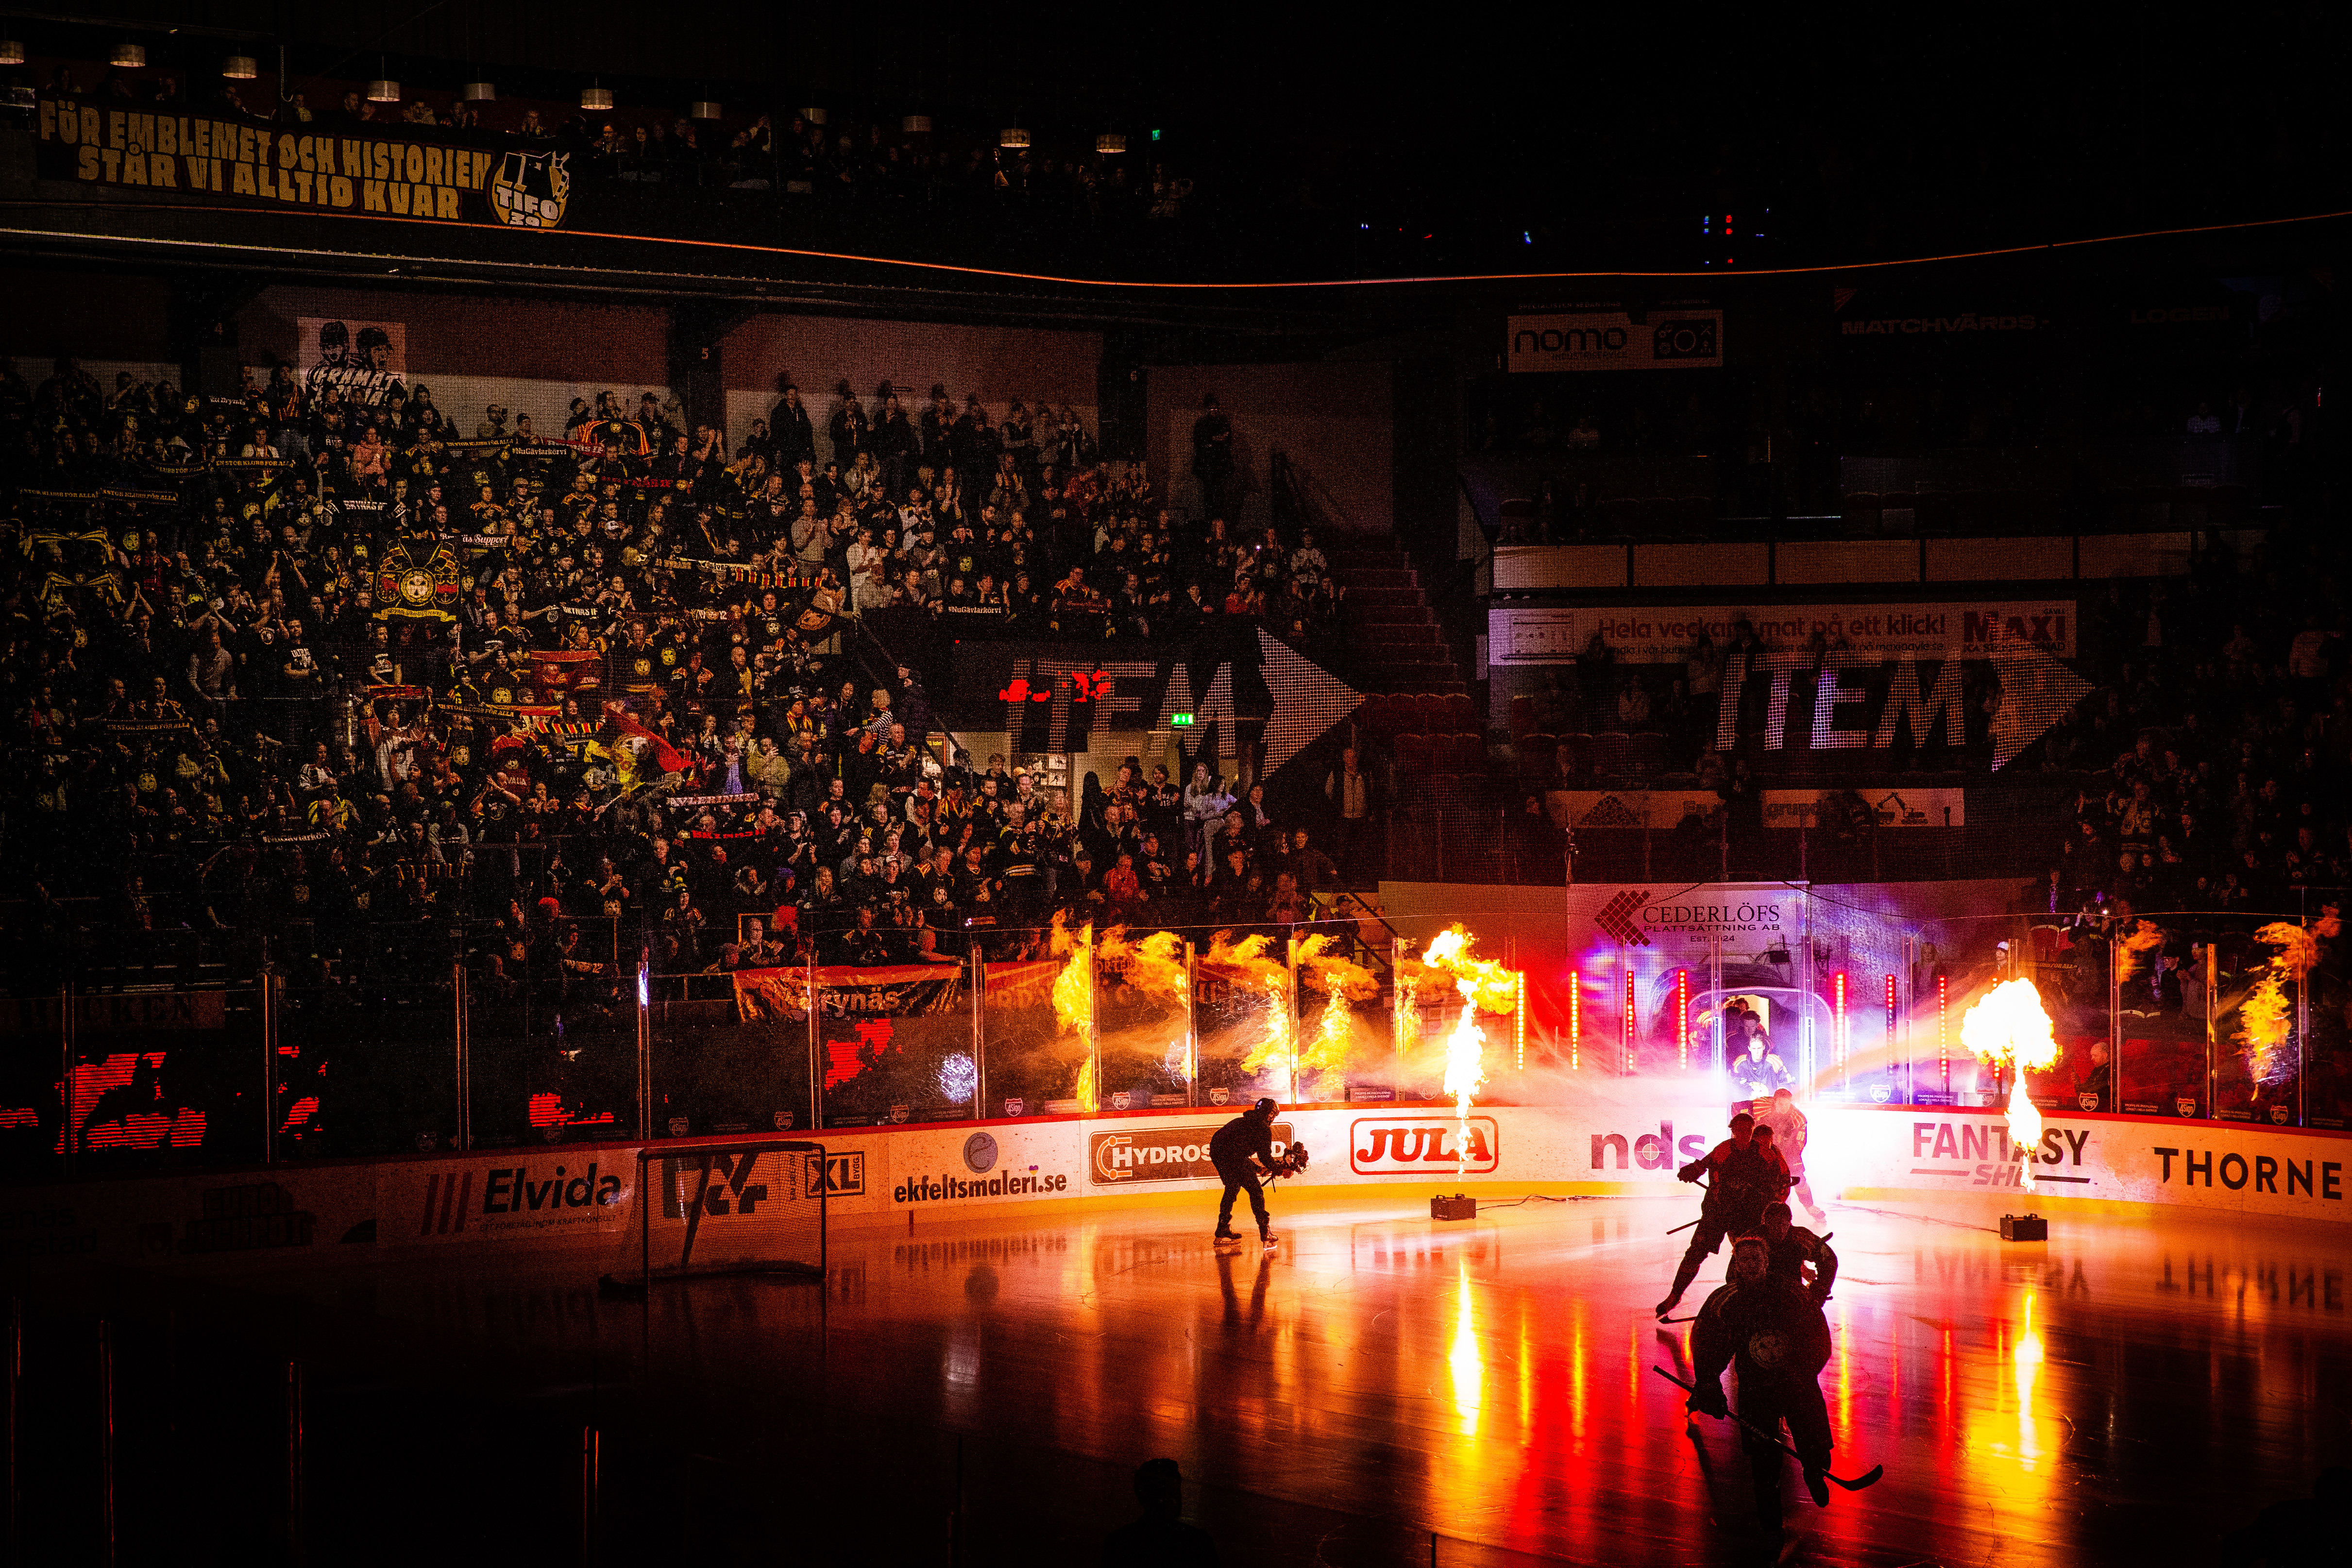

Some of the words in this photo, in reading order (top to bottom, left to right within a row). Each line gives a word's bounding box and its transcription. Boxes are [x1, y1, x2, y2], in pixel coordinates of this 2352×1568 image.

[40, 100, 100, 147] FÖR
[110, 111, 271, 165] EMBLEMET
[278, 134, 334, 175] OCH
[342, 139, 491, 191] HISTORIEN
[78, 141, 176, 188] STÅR
[187, 154, 222, 191] VI
[233, 162, 354, 208] ALLTID
[364, 180, 459, 219] KVAR
[495, 185, 559, 219] TIFO
[2131, 305, 2230, 324] LOGEN
[1514, 327, 1628, 354] nomo
[701, 348, 709, 360] 5
[1552, 351, 1628, 360] INDUSTRISERVICE
[1130, 371, 1137, 382] 6
[474, 534, 509, 545] Support
[948, 606, 1001, 614] #NuGävlarkörvi
[1599, 618, 1651, 639] Hela
[1760, 615, 1805, 637] mat
[1813, 613, 1842, 641] på
[1849, 615, 1881, 636] ett
[1887, 613, 1945, 635] klick!
[1963, 610, 2066, 641] MAXI
[1006, 658, 1236, 758] ITEM
[1715, 649, 1965, 750] ITEM
[262, 832, 331, 843] #NuGävlarkör
[1643, 902, 1780, 924] CEDERLÖFS
[1644, 923, 1756, 932] PLATTSÄTTNING
[807, 986, 900, 1016] rynäs
[1006, 1101, 1023, 1113] 4Sign
[1113, 1095, 1131, 1107] 4Sign
[1211, 1091, 1229, 1102] 4Sign
[2080, 1097, 2098, 1110] 4Sign
[2178, 1102, 2195, 1114] 4Sign
[775, 1115, 793, 1127] 4Sign
[1112, 1143, 1287, 1168] HYDROSD
[1356, 1128, 1492, 1163] JULA
[1591, 1121, 1706, 1170] nds
[2153, 1146, 2343, 1200] THORNE
[483, 1163, 621, 1214] Elvida
[895, 1166, 1067, 1205] ekfeltsmaleri.se
[531, 1218, 555, 1228] INOM
[557, 1214, 616, 1227] KRAFTKONSULT
